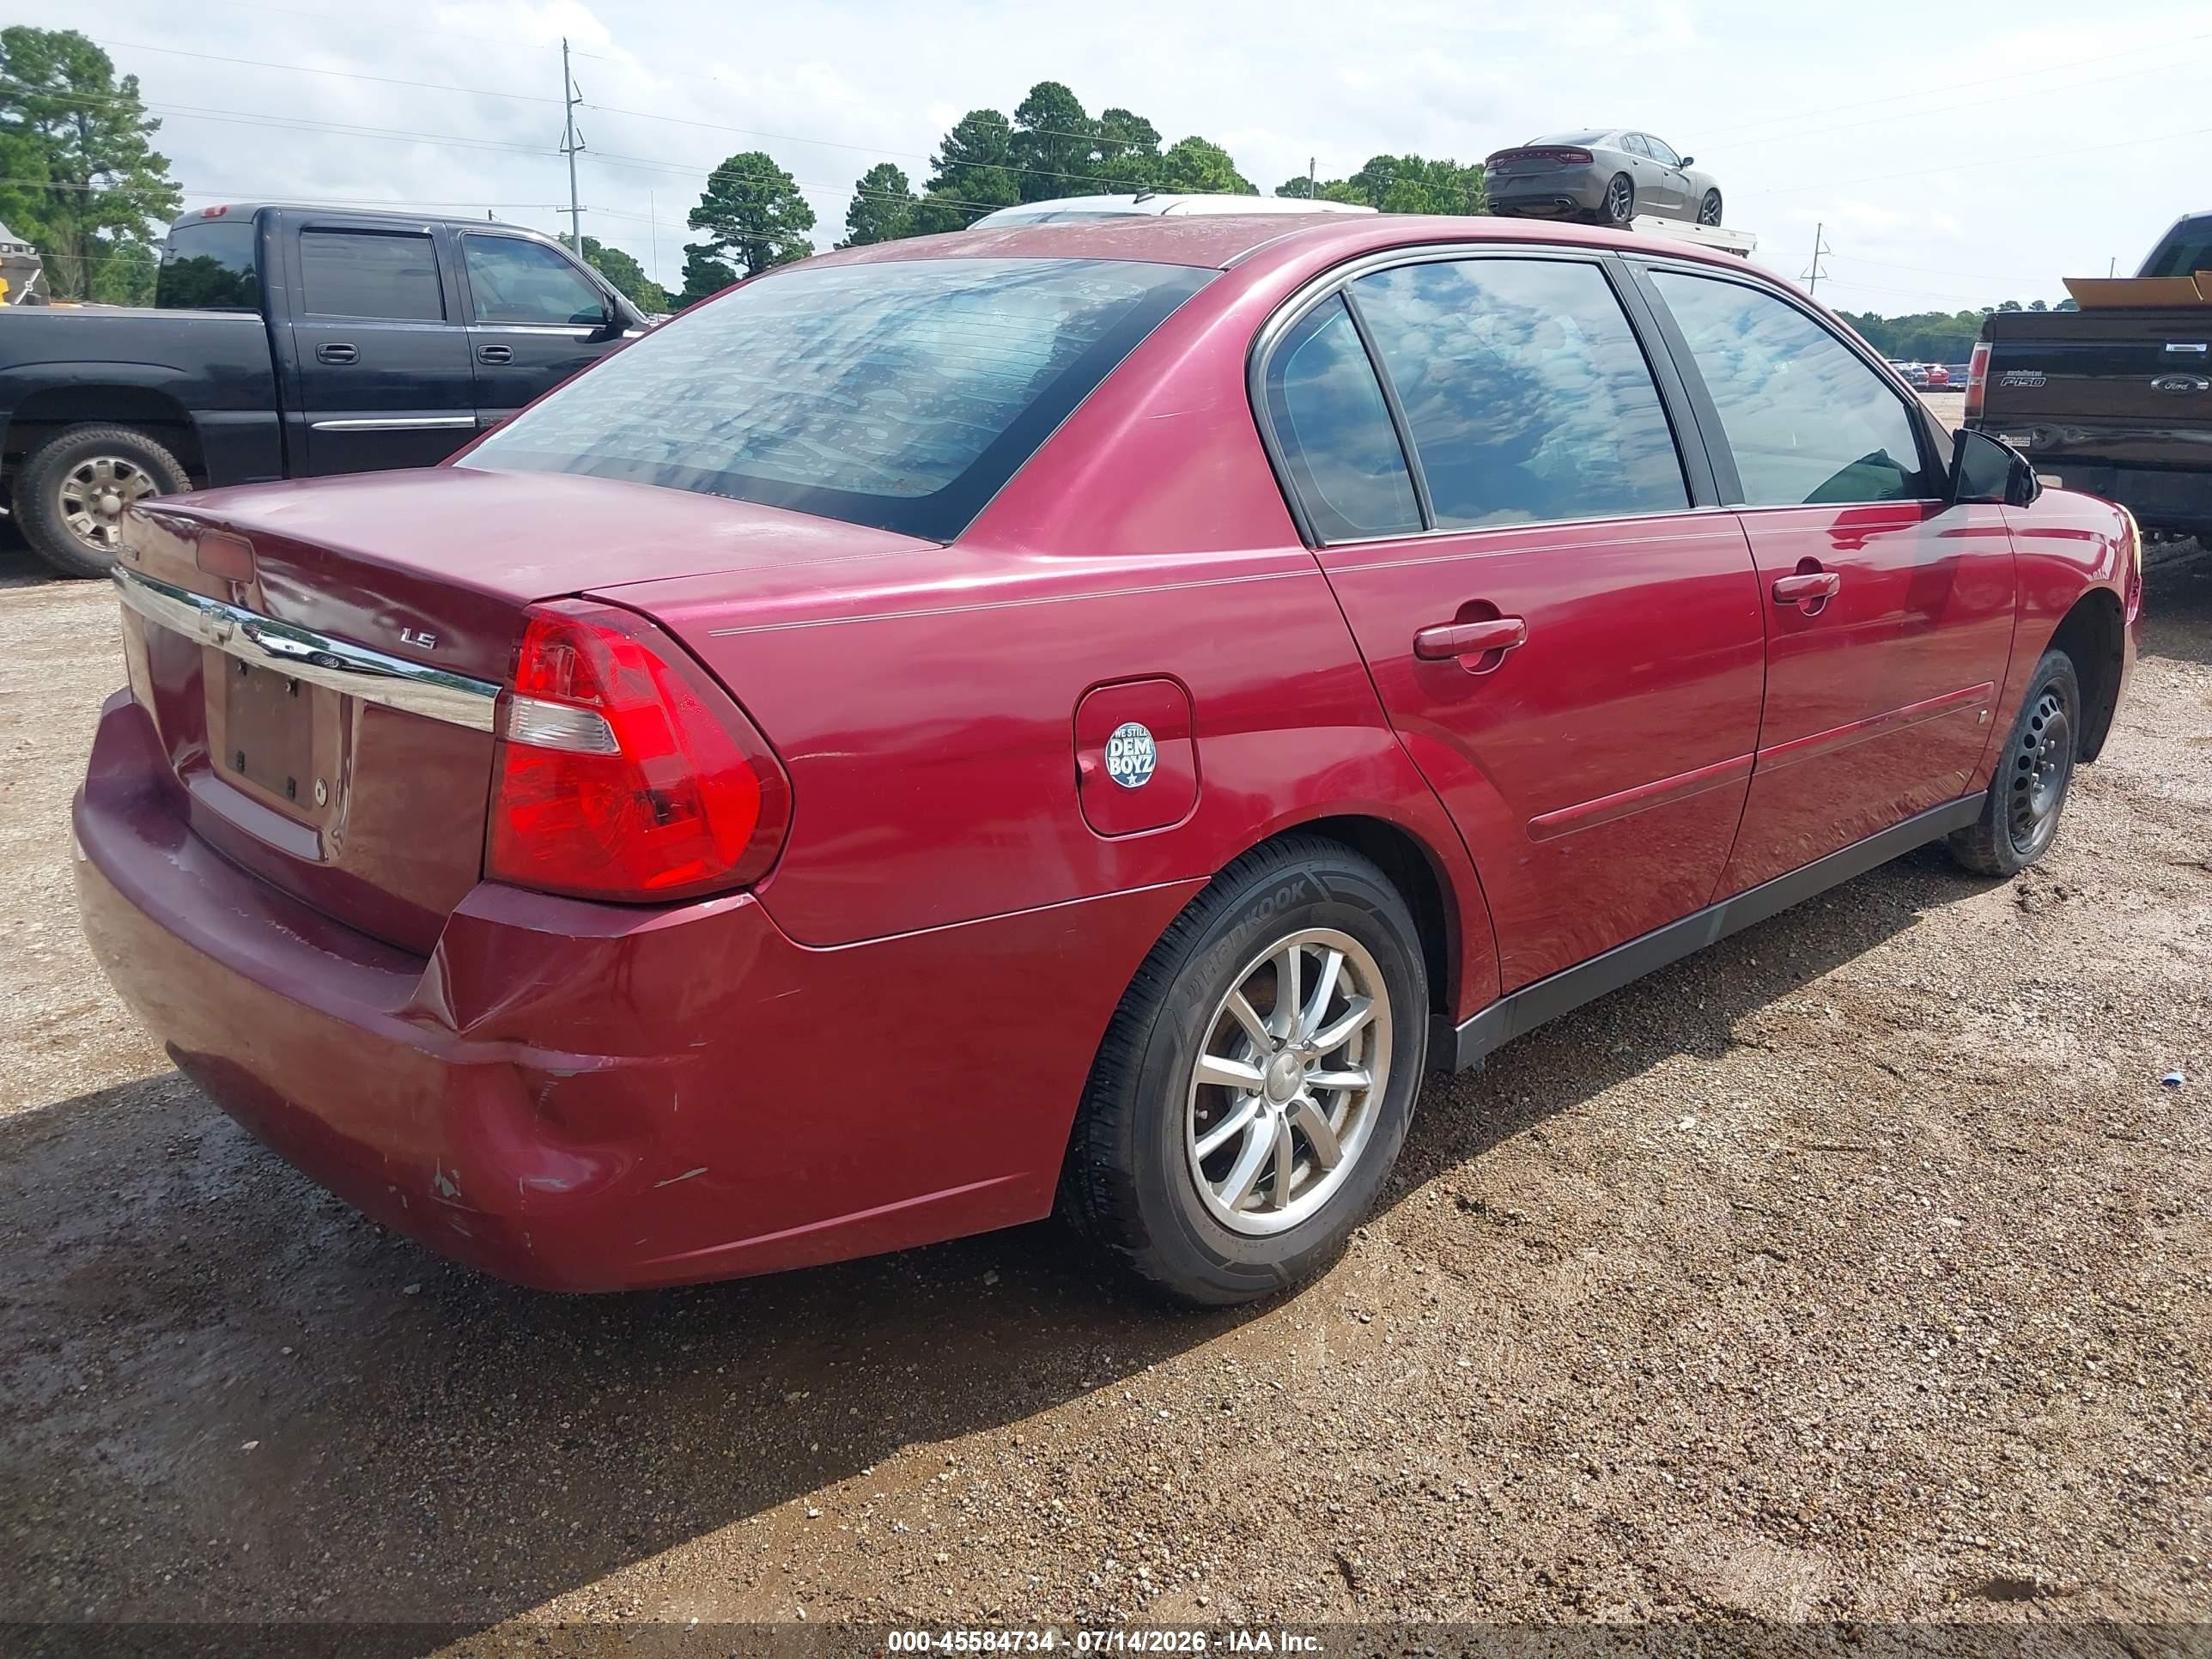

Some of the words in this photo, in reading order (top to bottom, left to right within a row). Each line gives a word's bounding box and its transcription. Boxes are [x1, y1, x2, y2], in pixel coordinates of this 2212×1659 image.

[400, 627, 437, 651] LS
[1115, 729, 1127, 738] WE
[1127, 727, 1148, 737] STILL
[1110, 738, 1152, 757] DEM
[1109, 755, 1153, 775] BOYZ
